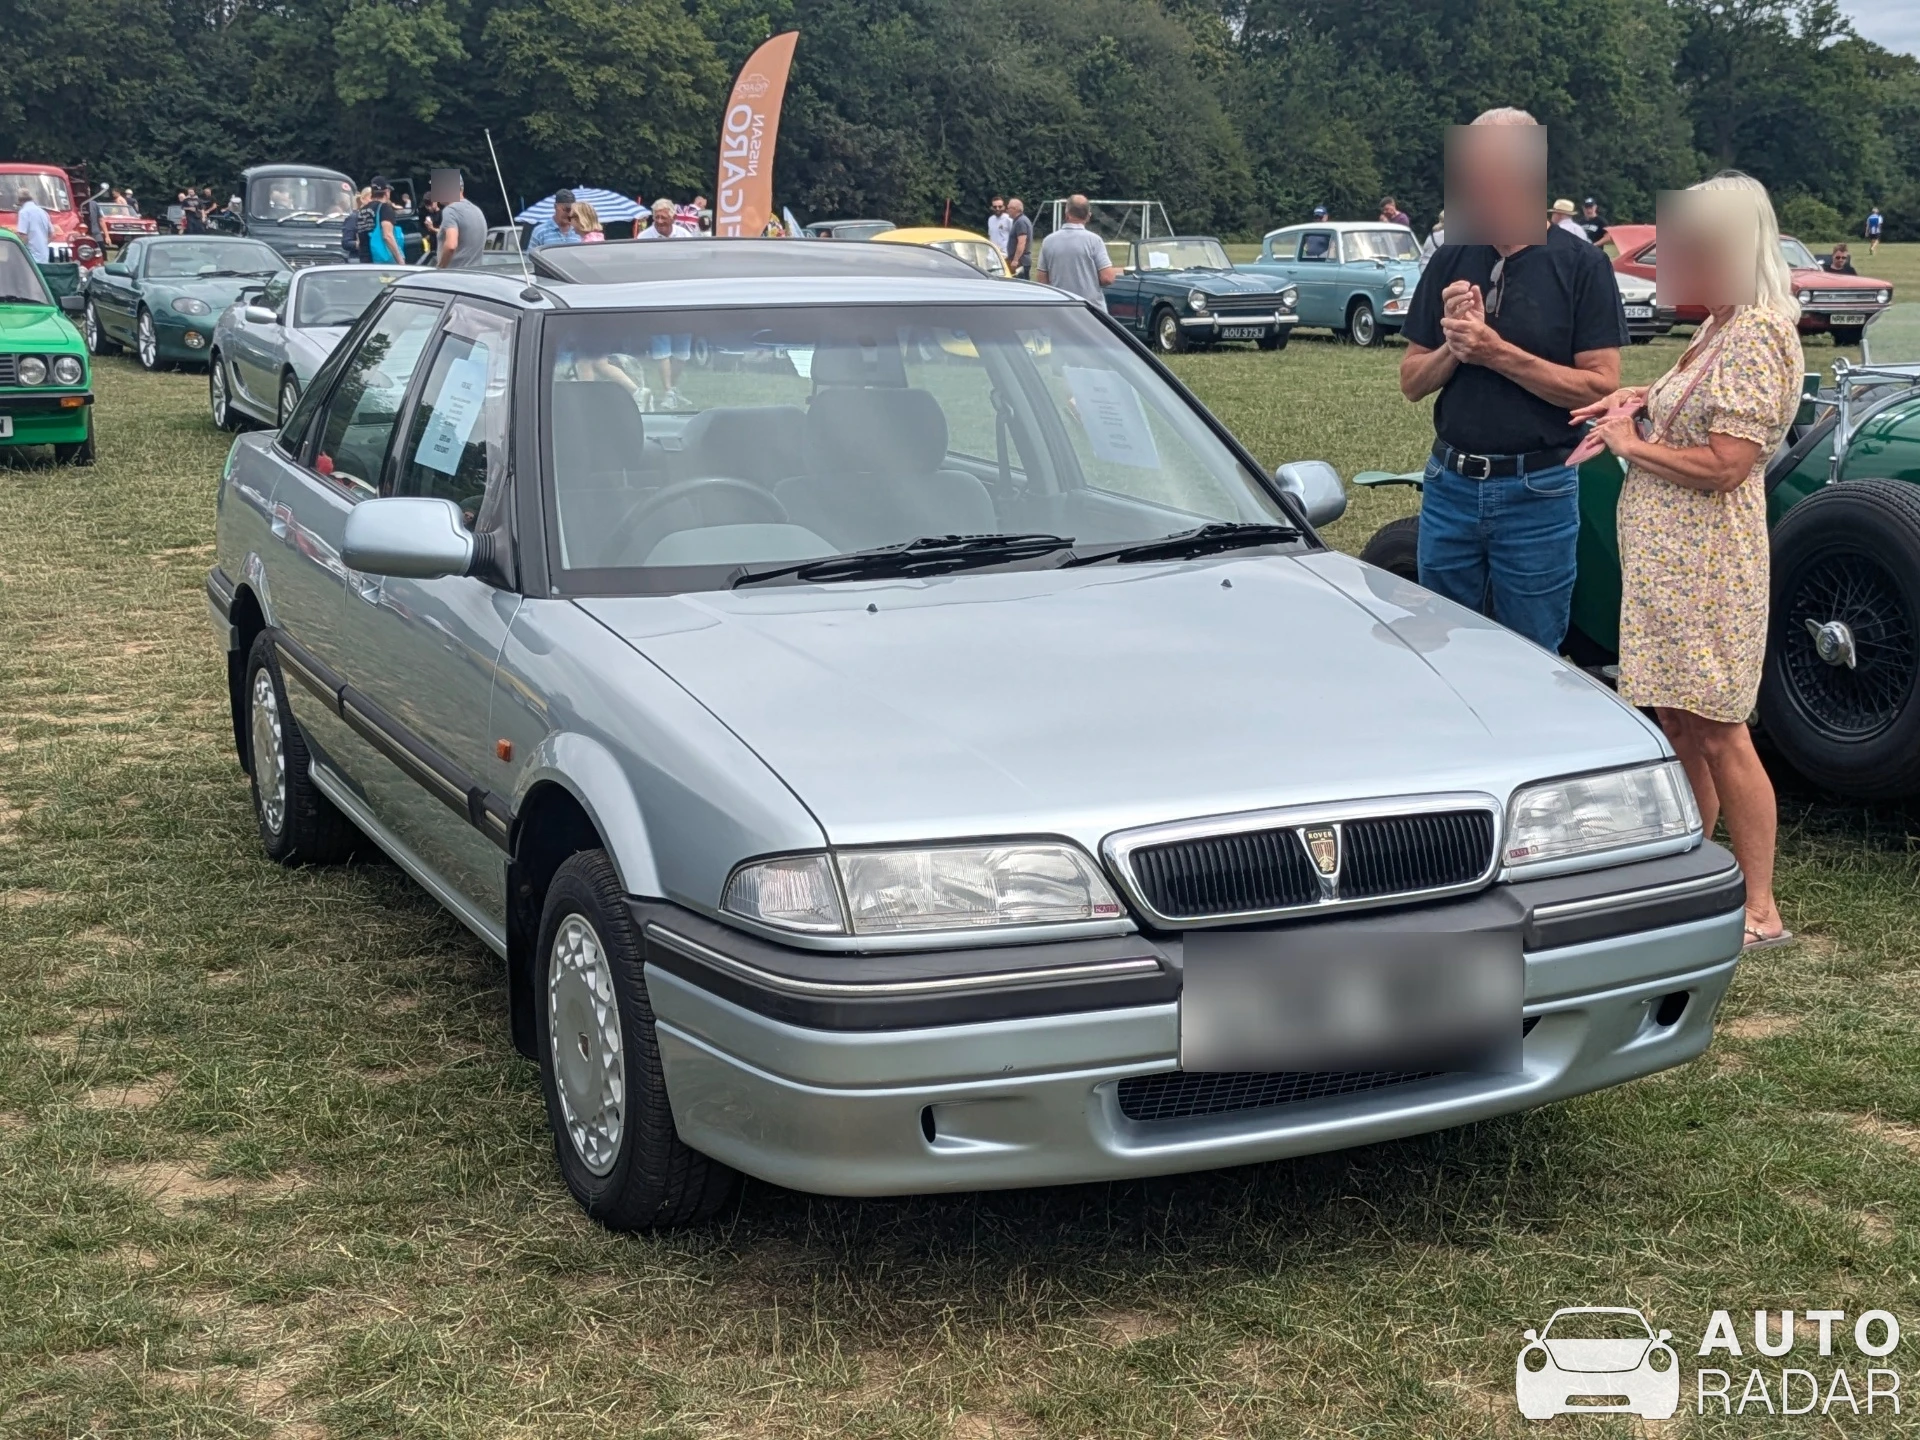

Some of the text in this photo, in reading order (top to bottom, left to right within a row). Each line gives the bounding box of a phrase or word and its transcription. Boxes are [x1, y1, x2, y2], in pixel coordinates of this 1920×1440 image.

[1223, 327, 1264, 337] AOU 373J
[1308, 831, 1333, 839] ROVER
